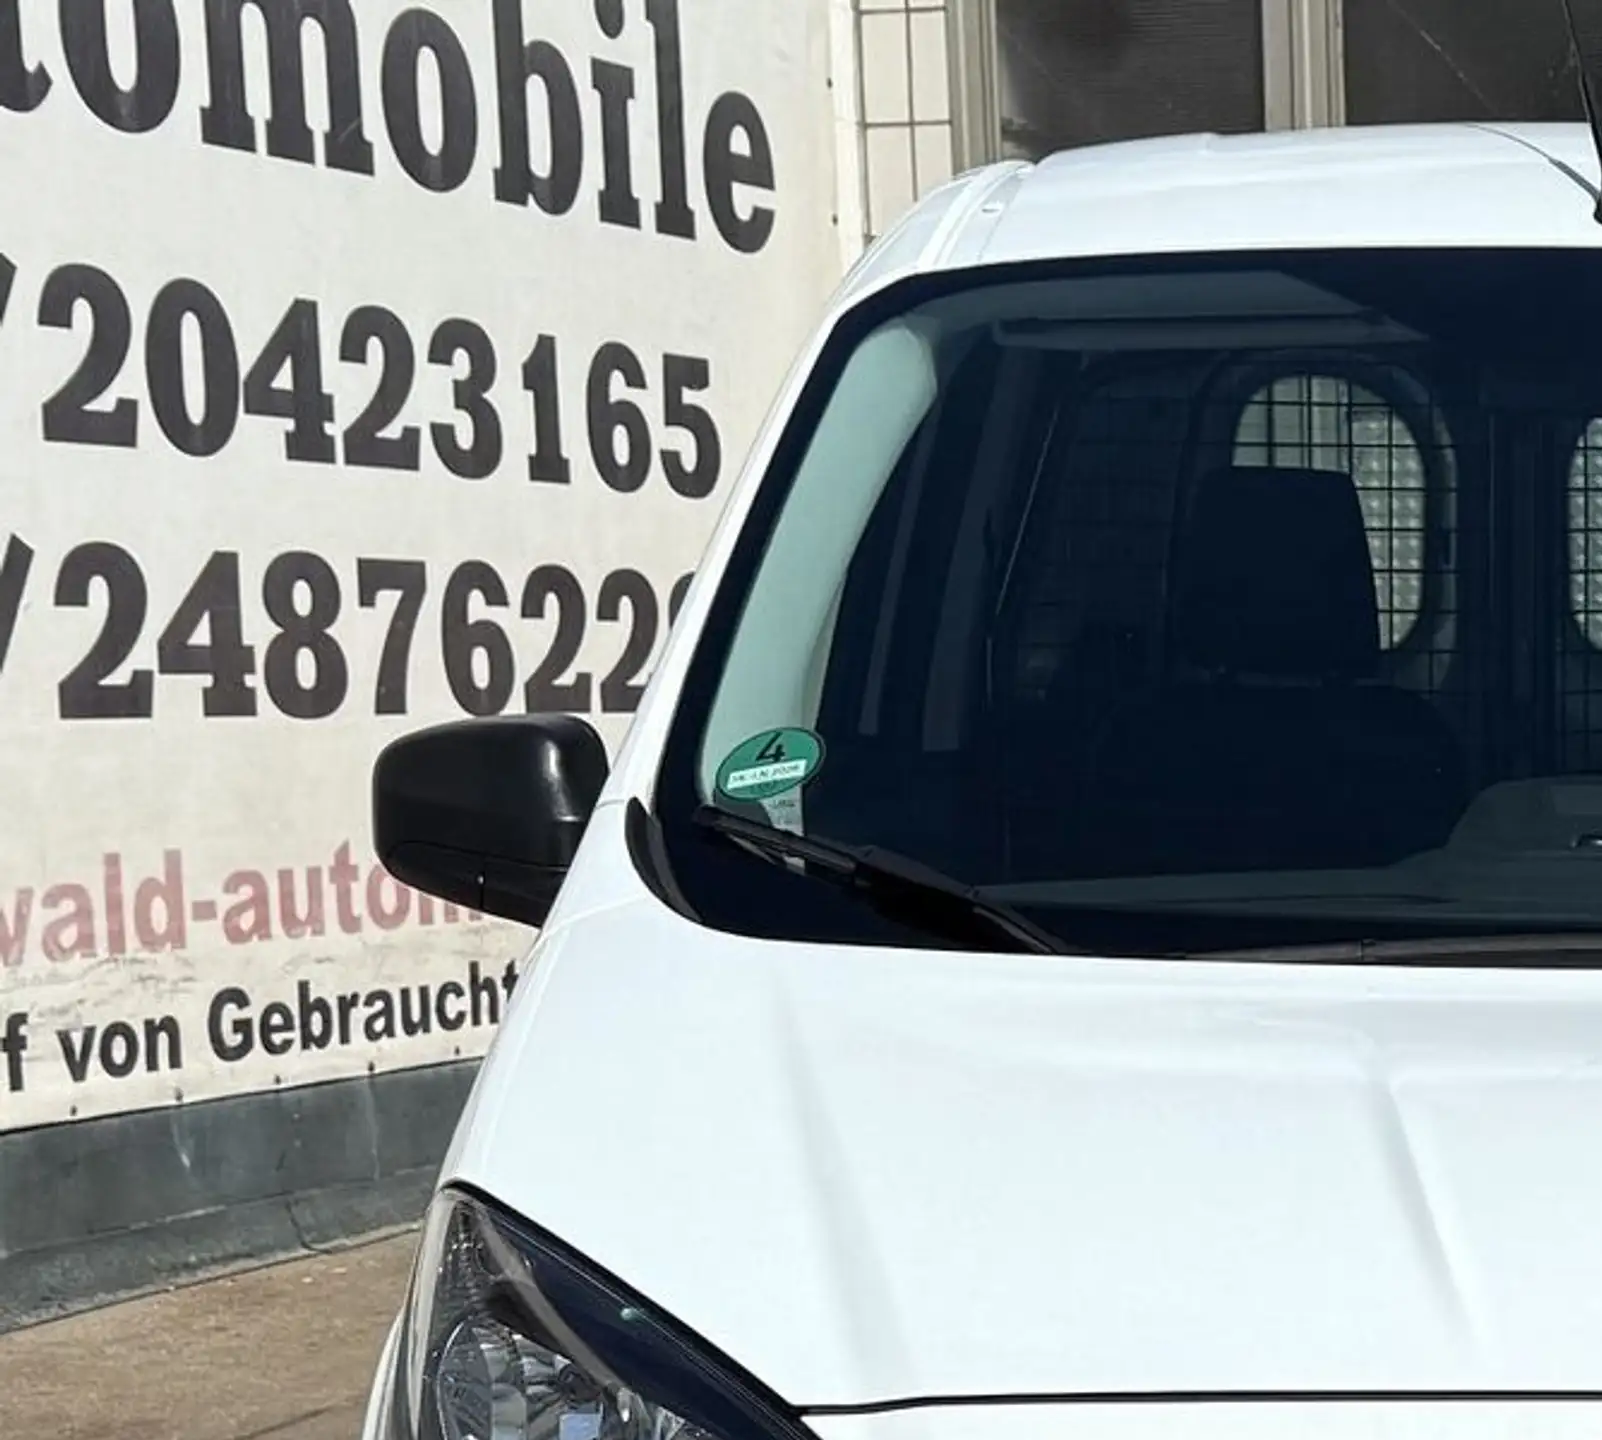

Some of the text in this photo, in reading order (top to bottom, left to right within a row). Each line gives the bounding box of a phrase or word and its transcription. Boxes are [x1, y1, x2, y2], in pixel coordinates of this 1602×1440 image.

[0, 252, 721, 499] 20423165
[0, 534, 697, 720] /2487622
[755, 731, 786, 763] 4
[56, 1015, 182, 1083] von
